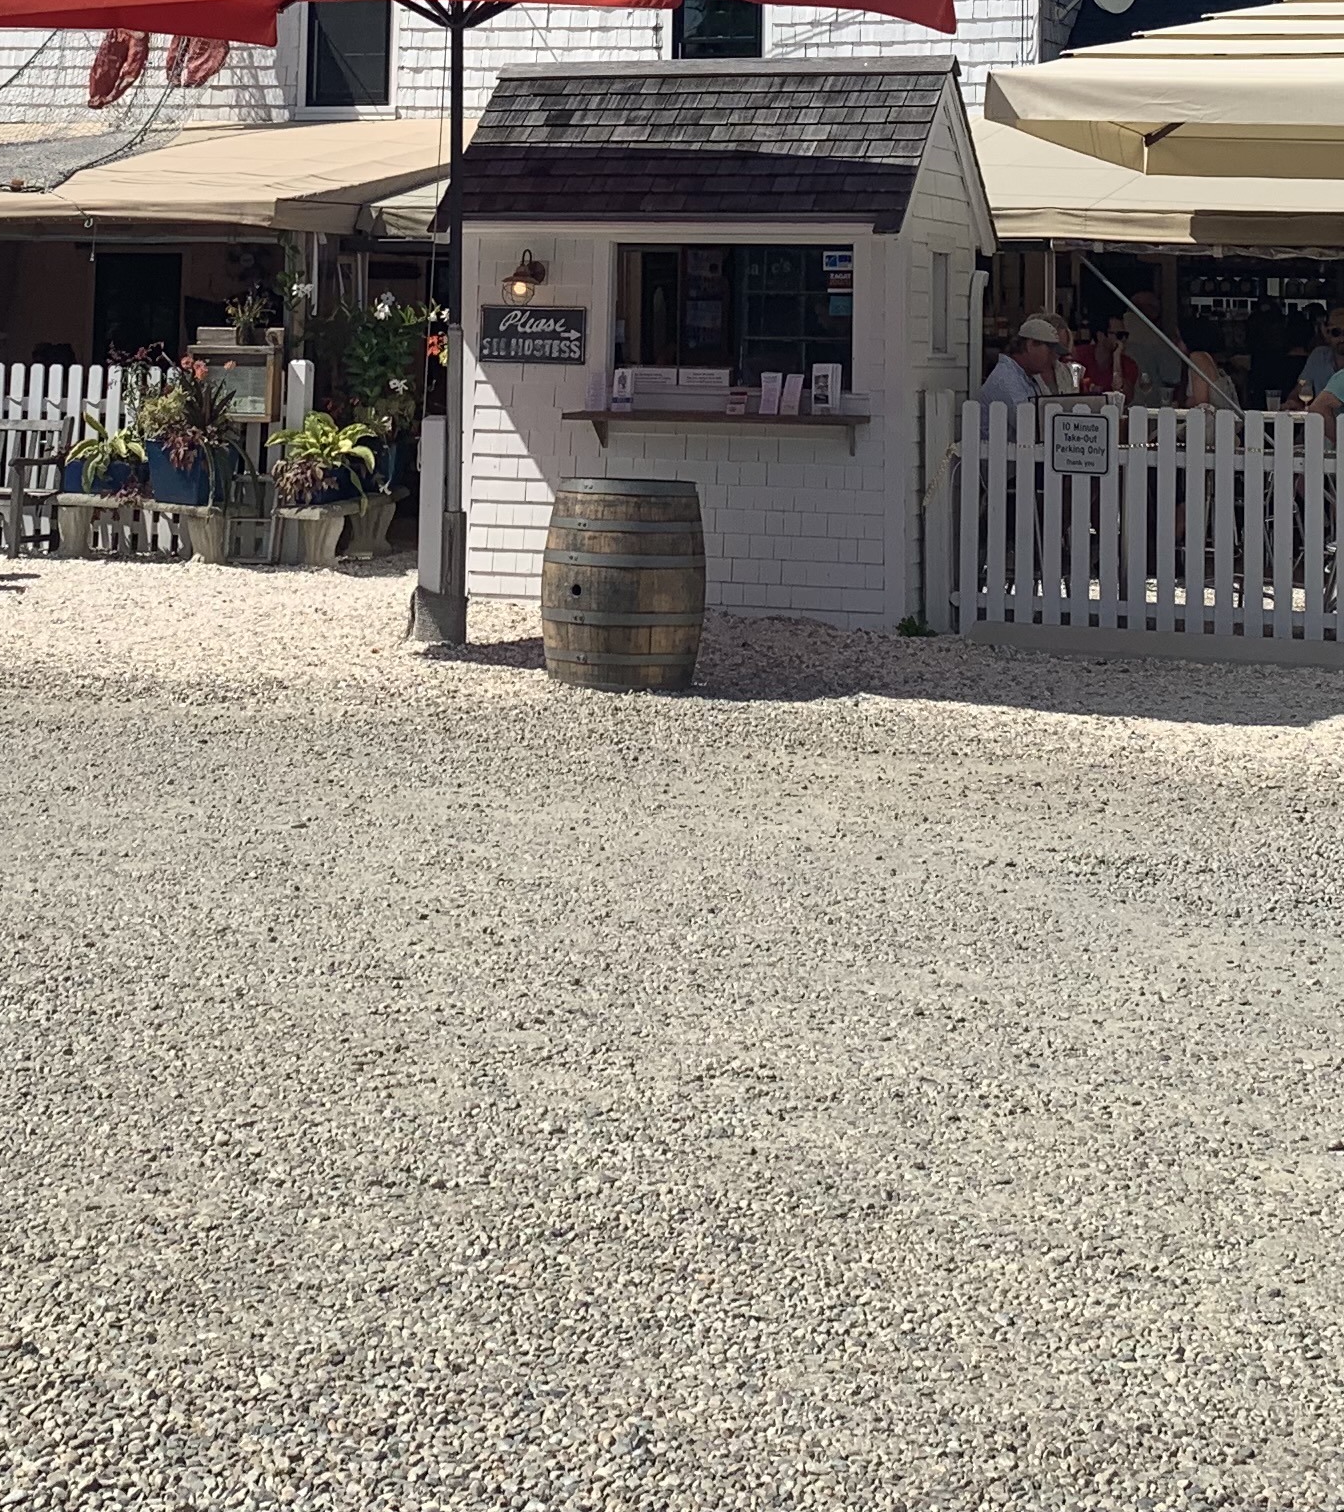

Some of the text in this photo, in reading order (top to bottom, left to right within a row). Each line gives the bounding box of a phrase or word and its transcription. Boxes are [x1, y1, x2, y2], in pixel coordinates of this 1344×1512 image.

[499, 310, 566, 333] Please
[510, 338, 581, 359] HOSTESS
[1062, 422, 1099, 432] 10 Minute
[1064, 433, 1097, 443] Take-Out
[1056, 444, 1105, 456] Parking Only
